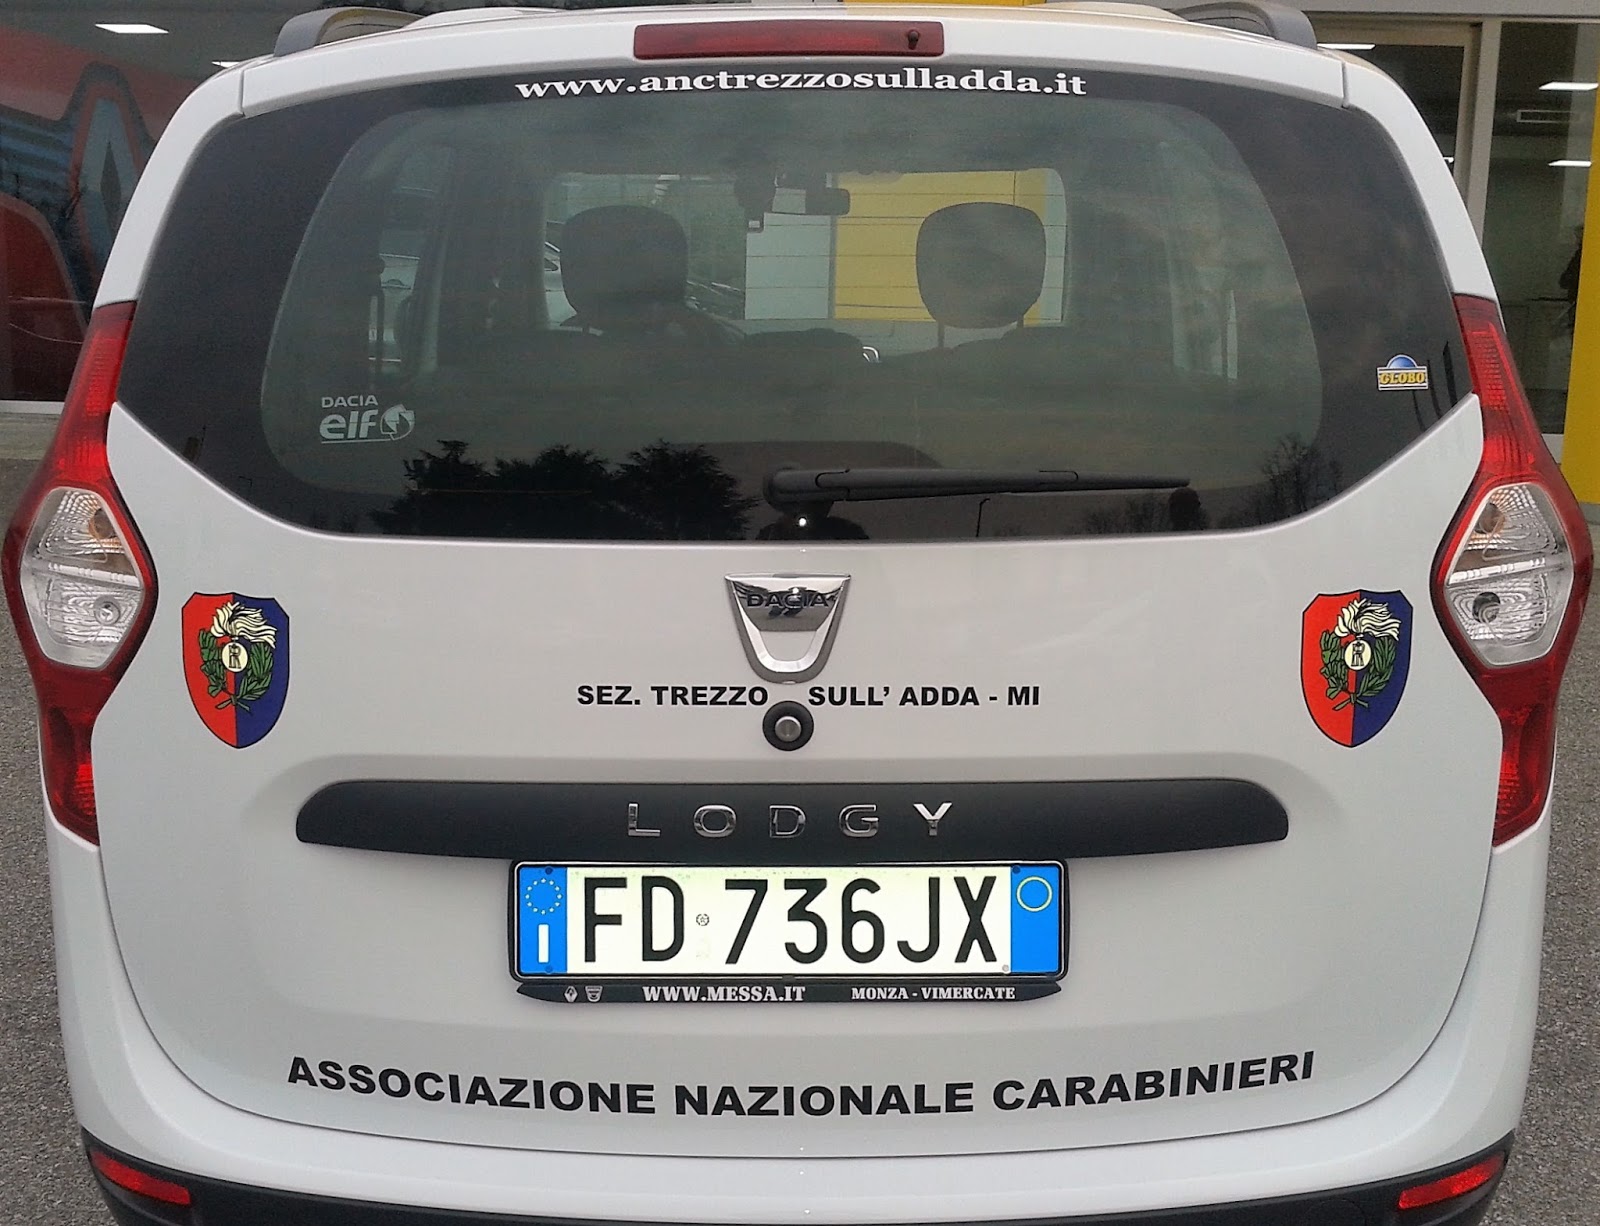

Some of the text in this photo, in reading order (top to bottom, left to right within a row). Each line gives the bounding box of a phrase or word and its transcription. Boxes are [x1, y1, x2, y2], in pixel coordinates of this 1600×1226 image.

[514, 67, 1087, 99] www.anctrezzosulladda.it
[1380, 372, 1425, 384] GLOBO
[321, 395, 378, 408] DACIA
[319, 409, 379, 440] elf
[746, 591, 829, 609] DACIA
[577, 685, 641, 706] SEZ.
[650, 685, 768, 706] TREZZO
[899, 686, 980, 706] ADDA
[1007, 686, 1040, 706] MI
[627, 802, 953, 838] LODGY
[642, 985, 806, 1002] WWW.MESSA.IT
[851, 986, 909, 1001] MONZA
[920, 986, 1016, 1001] VIMERCATE
[288, 1050, 1314, 1117] ASSOCIAZIONE NAZIONALE CARABINIERI
